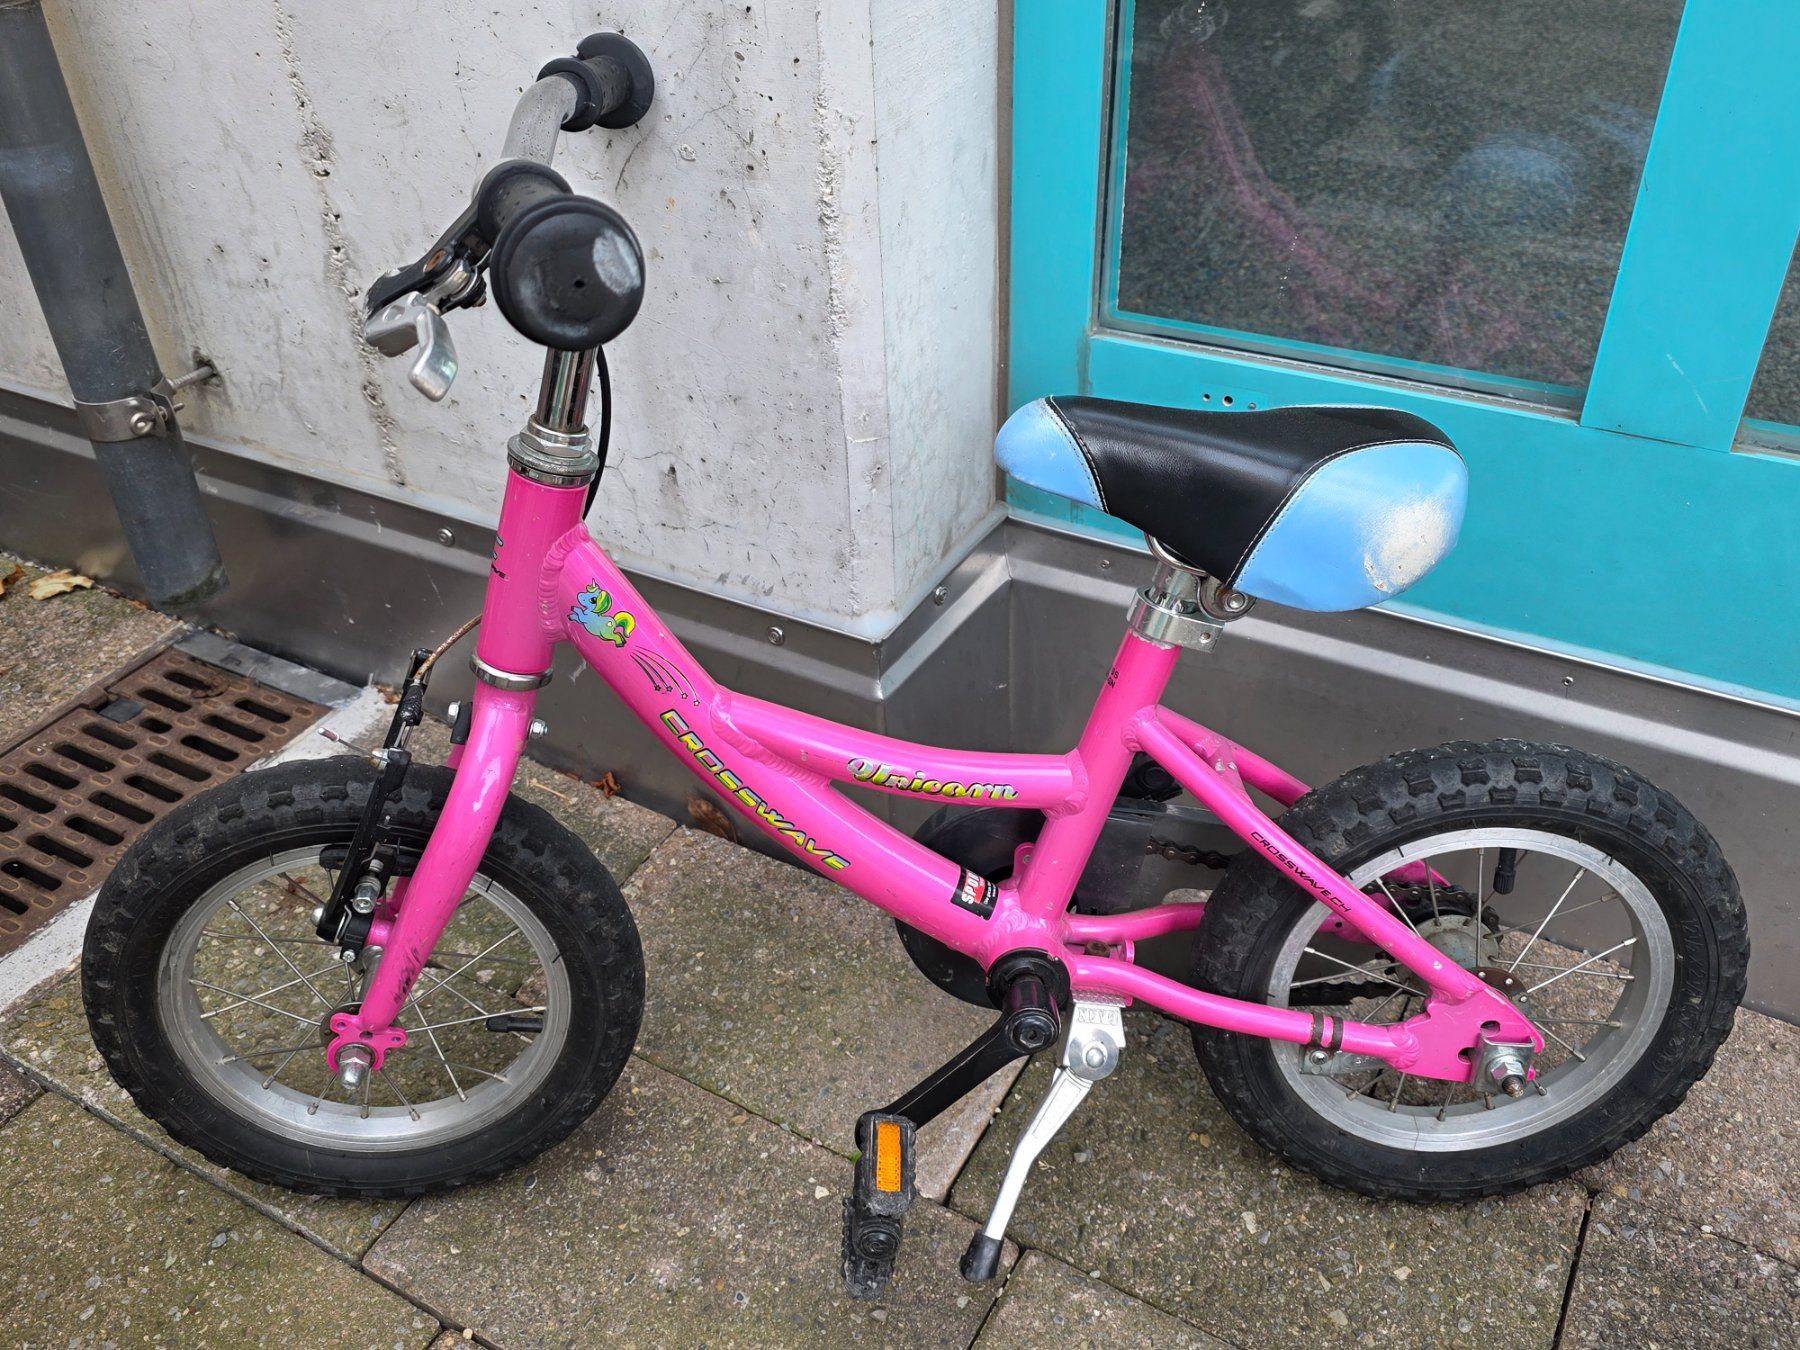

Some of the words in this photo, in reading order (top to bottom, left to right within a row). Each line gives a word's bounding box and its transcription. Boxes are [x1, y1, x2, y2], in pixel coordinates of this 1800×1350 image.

[659, 708, 851, 871] CROSSWAVE
[847, 757, 1019, 800] Unicorn
[1250, 831, 1352, 912] CROSSWAVE.CH
